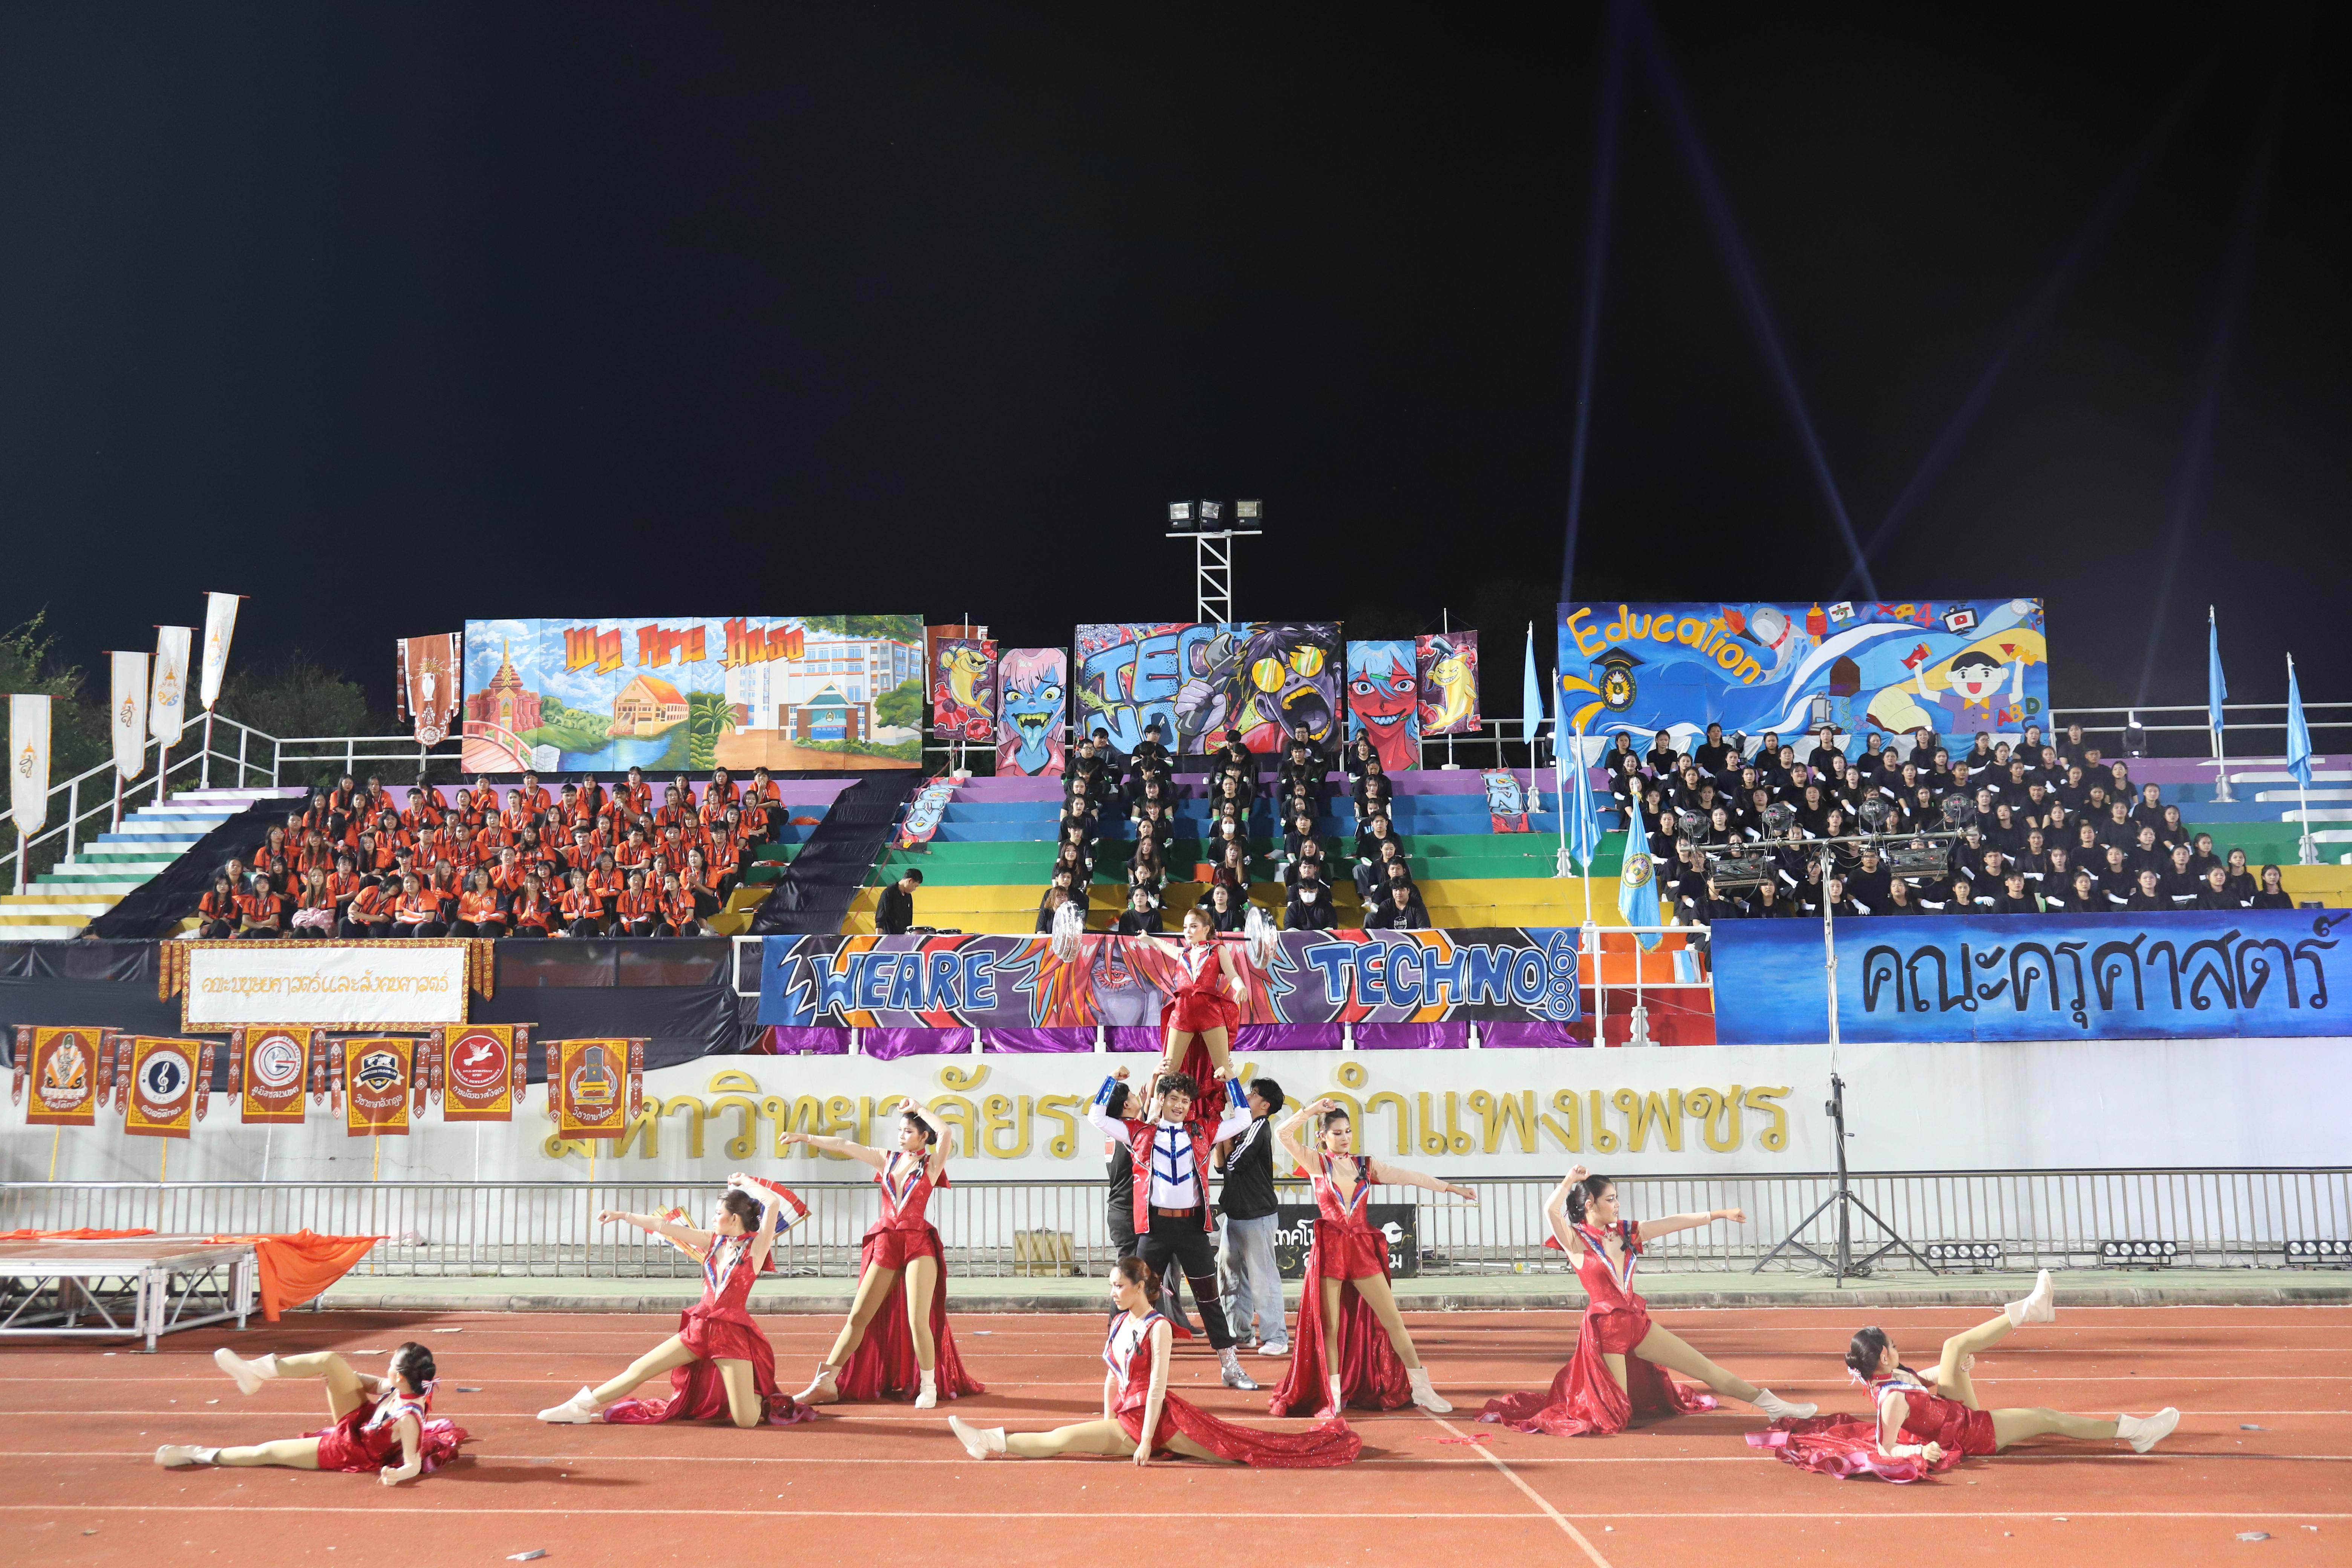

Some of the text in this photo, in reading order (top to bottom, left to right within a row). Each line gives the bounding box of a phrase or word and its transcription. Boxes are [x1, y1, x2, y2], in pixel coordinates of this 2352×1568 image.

[1913, 603, 1935, 627] 4
[563, 625, 624, 676] We
[635, 623, 706, 669] Are
[1566, 604, 1761, 684] Education
[202, 968, 450, 998] คณะมนุษยศาสตร์และสังคมศาสตร์
[1302, 940, 1551, 1008] TECHNO
[1863, 912, 2351, 1029] คณะครุศาสตร์
[142, 1053, 187, 1080] MUSIC EDUCATION
[360, 1069, 377, 1077] ENGLISH
[455, 1068, 501, 1084] SOCIAL DEVELOPMENT
[572, 1106, 613, 1121] วิชาภาษาไทย
